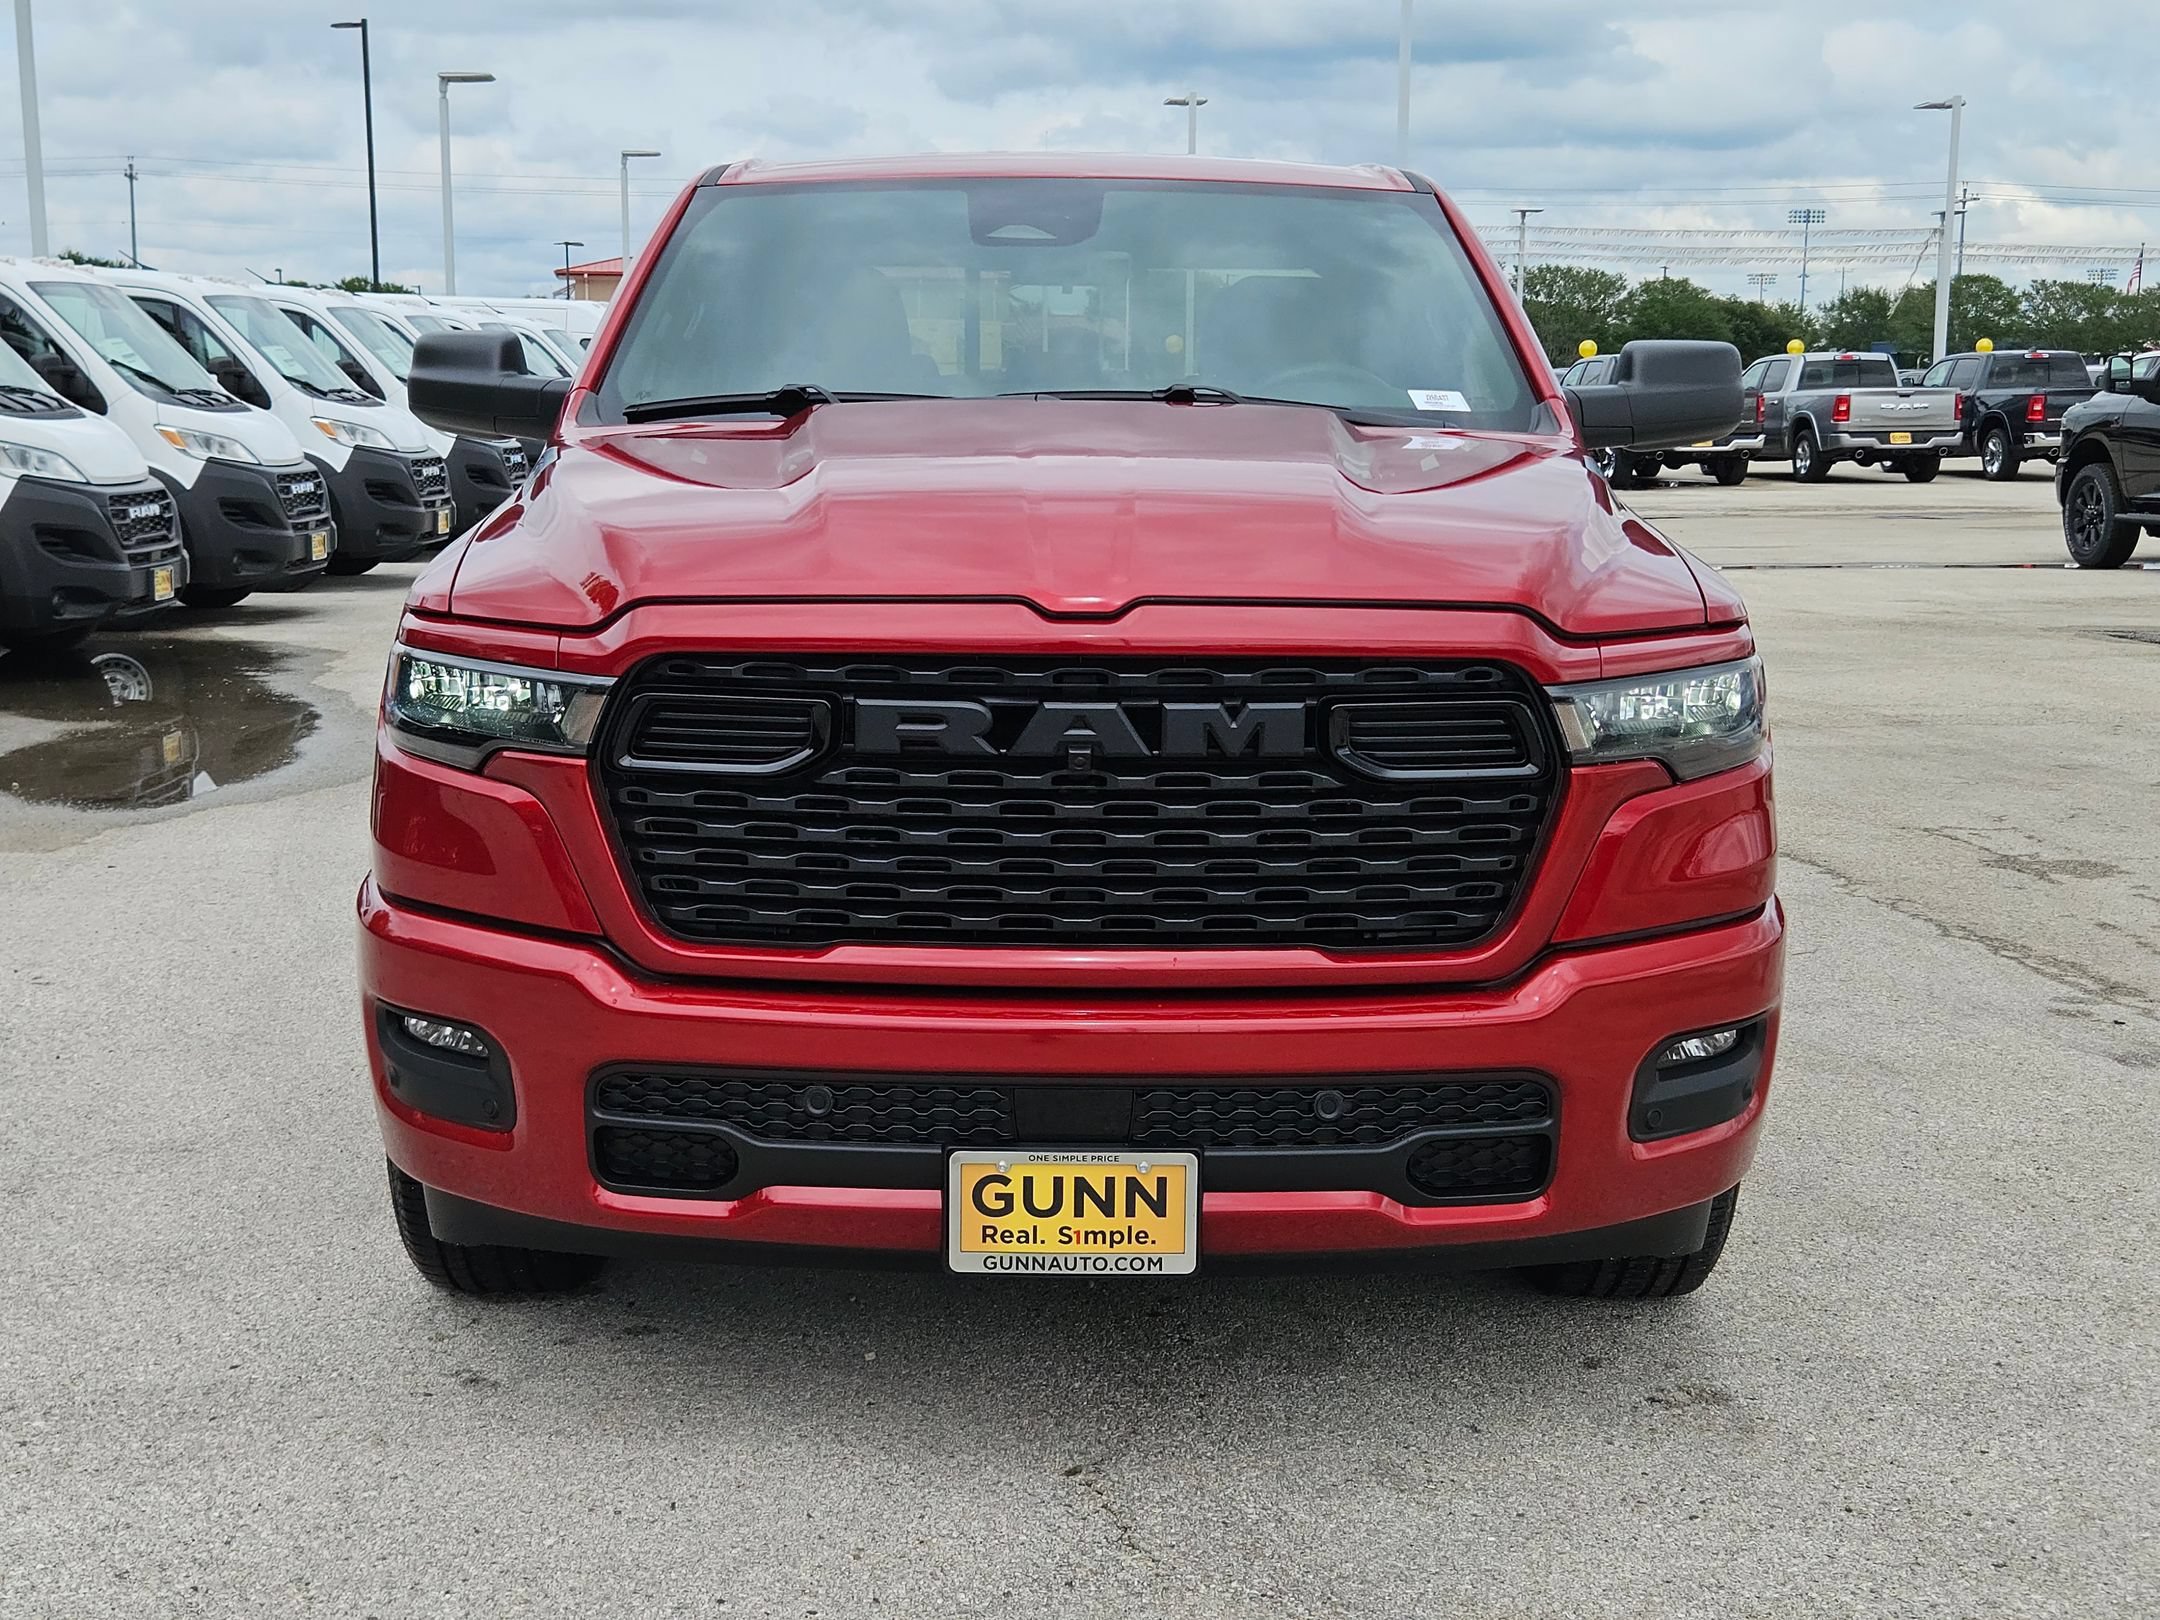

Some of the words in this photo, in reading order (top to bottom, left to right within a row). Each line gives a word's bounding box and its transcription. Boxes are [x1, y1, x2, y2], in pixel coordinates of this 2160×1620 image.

[129, 504, 160, 518] RAM
[855, 698, 1305, 756] RAM
[1028, 1154, 1050, 1162] ONE
[1052, 1154, 1088, 1162] SIMPLE
[1091, 1154, 1120, 1163] PRICE
[971, 1173, 1168, 1218] GUNN
[981, 1225, 1046, 1245] Real.
[982, 1255, 1164, 1272] GUNNAUTO.COM
